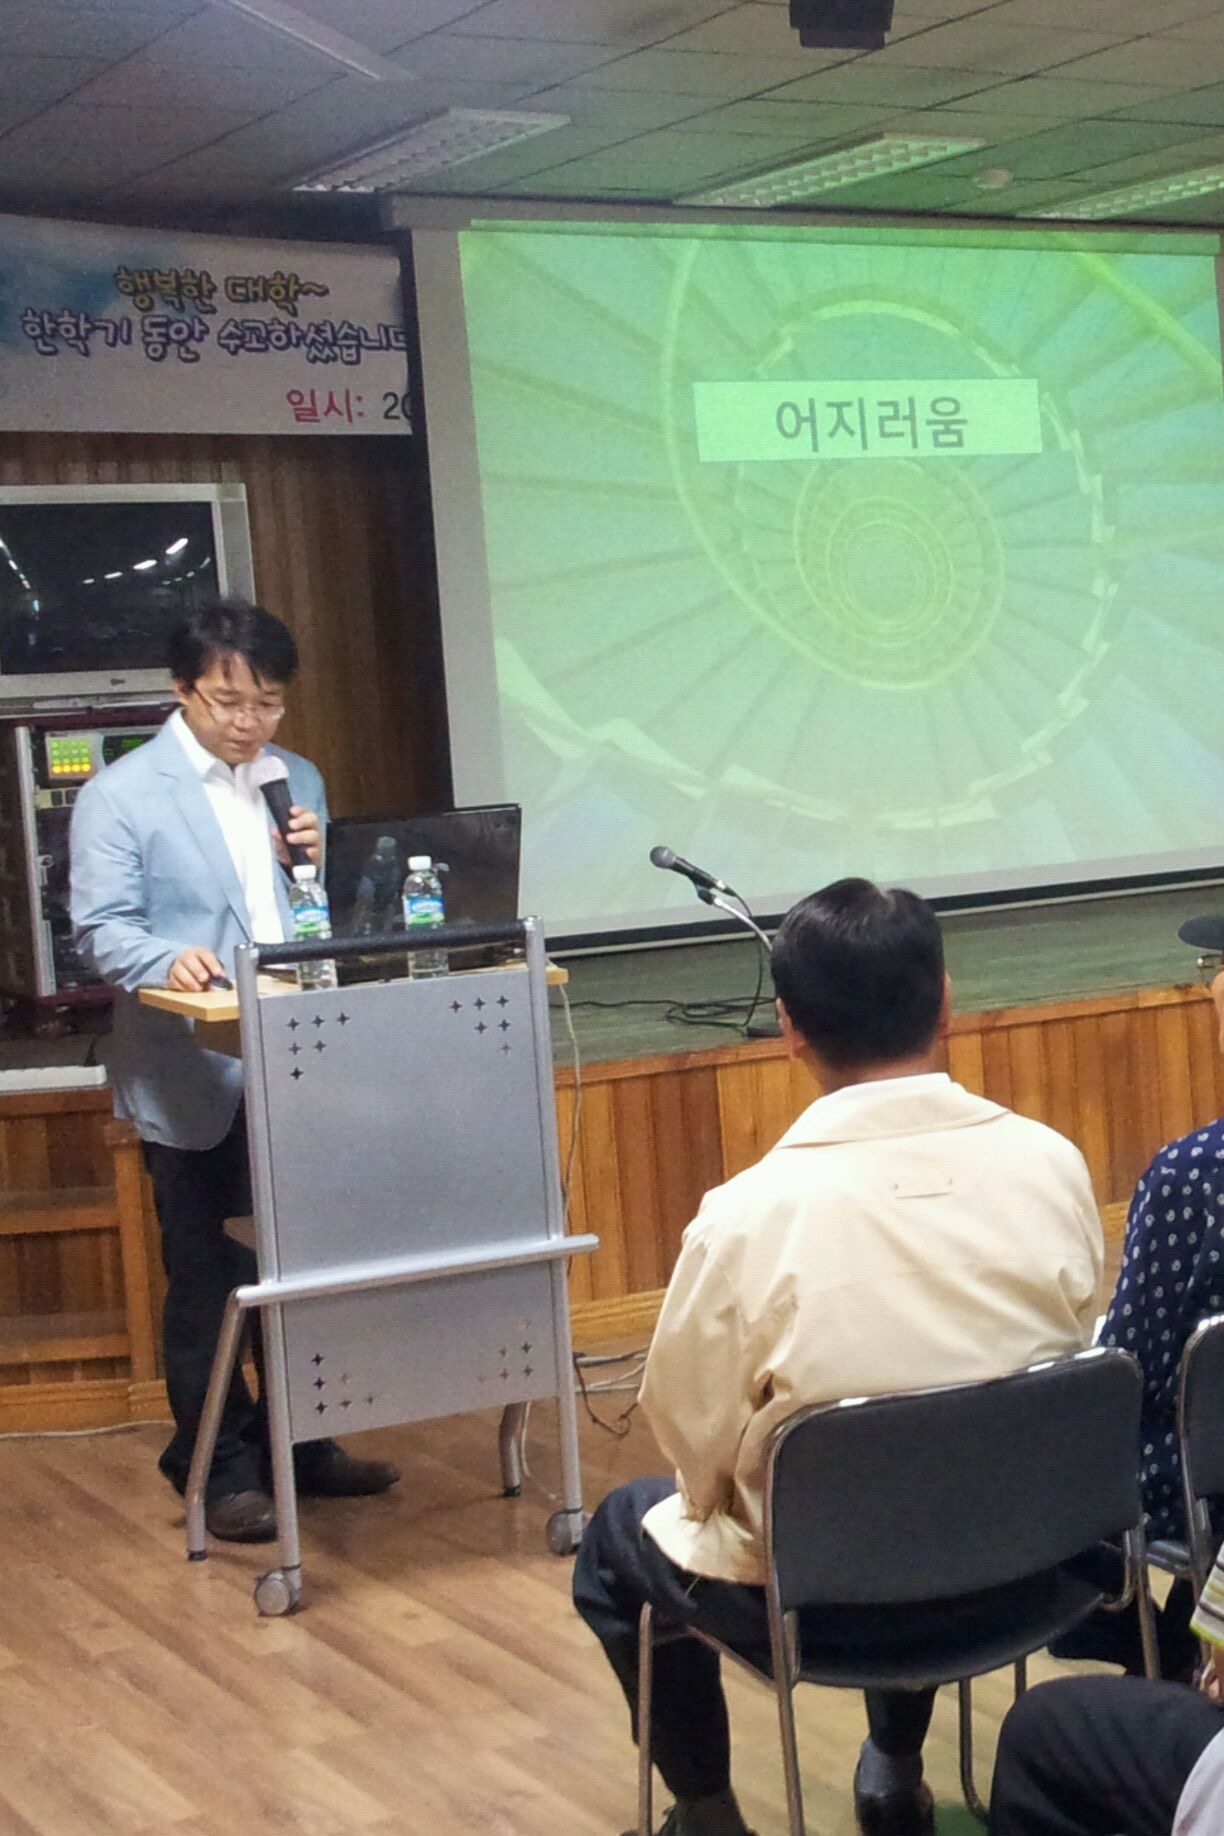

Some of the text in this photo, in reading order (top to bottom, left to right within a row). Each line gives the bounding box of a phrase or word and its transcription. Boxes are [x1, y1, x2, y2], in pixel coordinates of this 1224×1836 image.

[113, 265, 330, 317] 행복한 대학~
[19, 308, 132, 356] 한학기
[141, 315, 209, 363] 동안
[286, 387, 365, 424] 일시:
[775, 396, 969, 453] 어지러움
